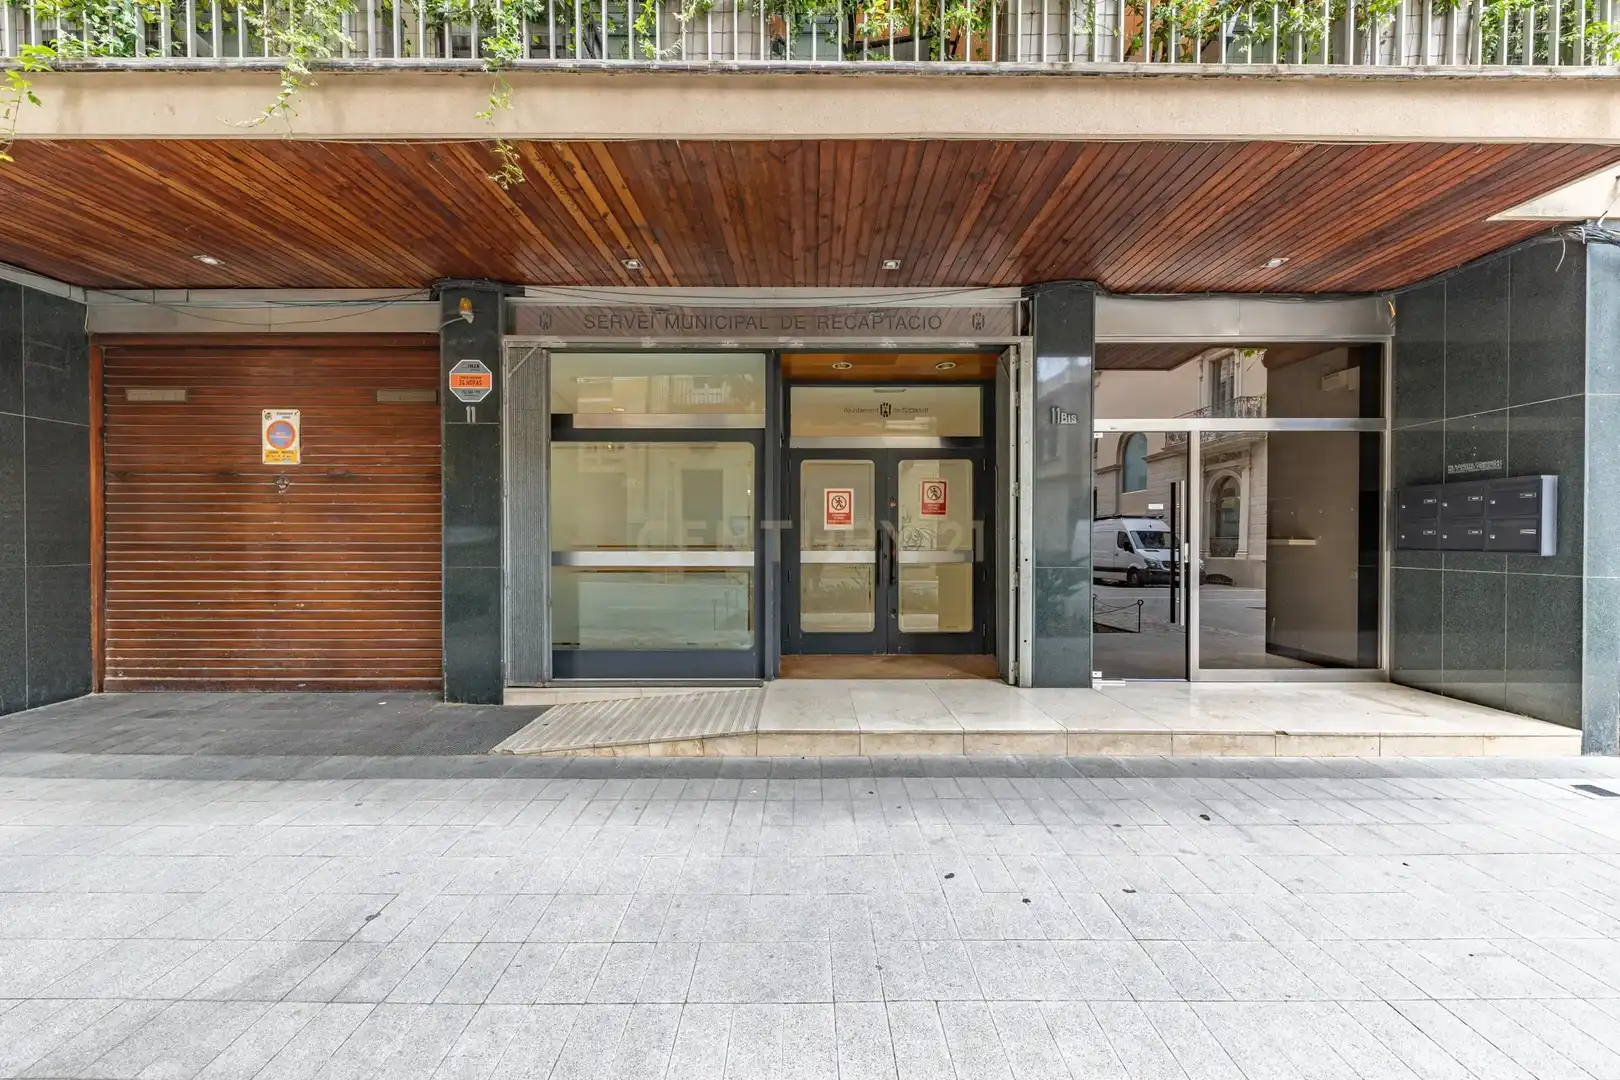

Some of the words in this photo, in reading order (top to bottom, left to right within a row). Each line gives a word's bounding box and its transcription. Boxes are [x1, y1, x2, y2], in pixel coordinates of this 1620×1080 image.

[583, 314, 656, 330] SERVEI
[665, 314, 770, 330] MUNICIPAL
[780, 314, 807, 330] DE
[465, 406, 476, 423] 11
